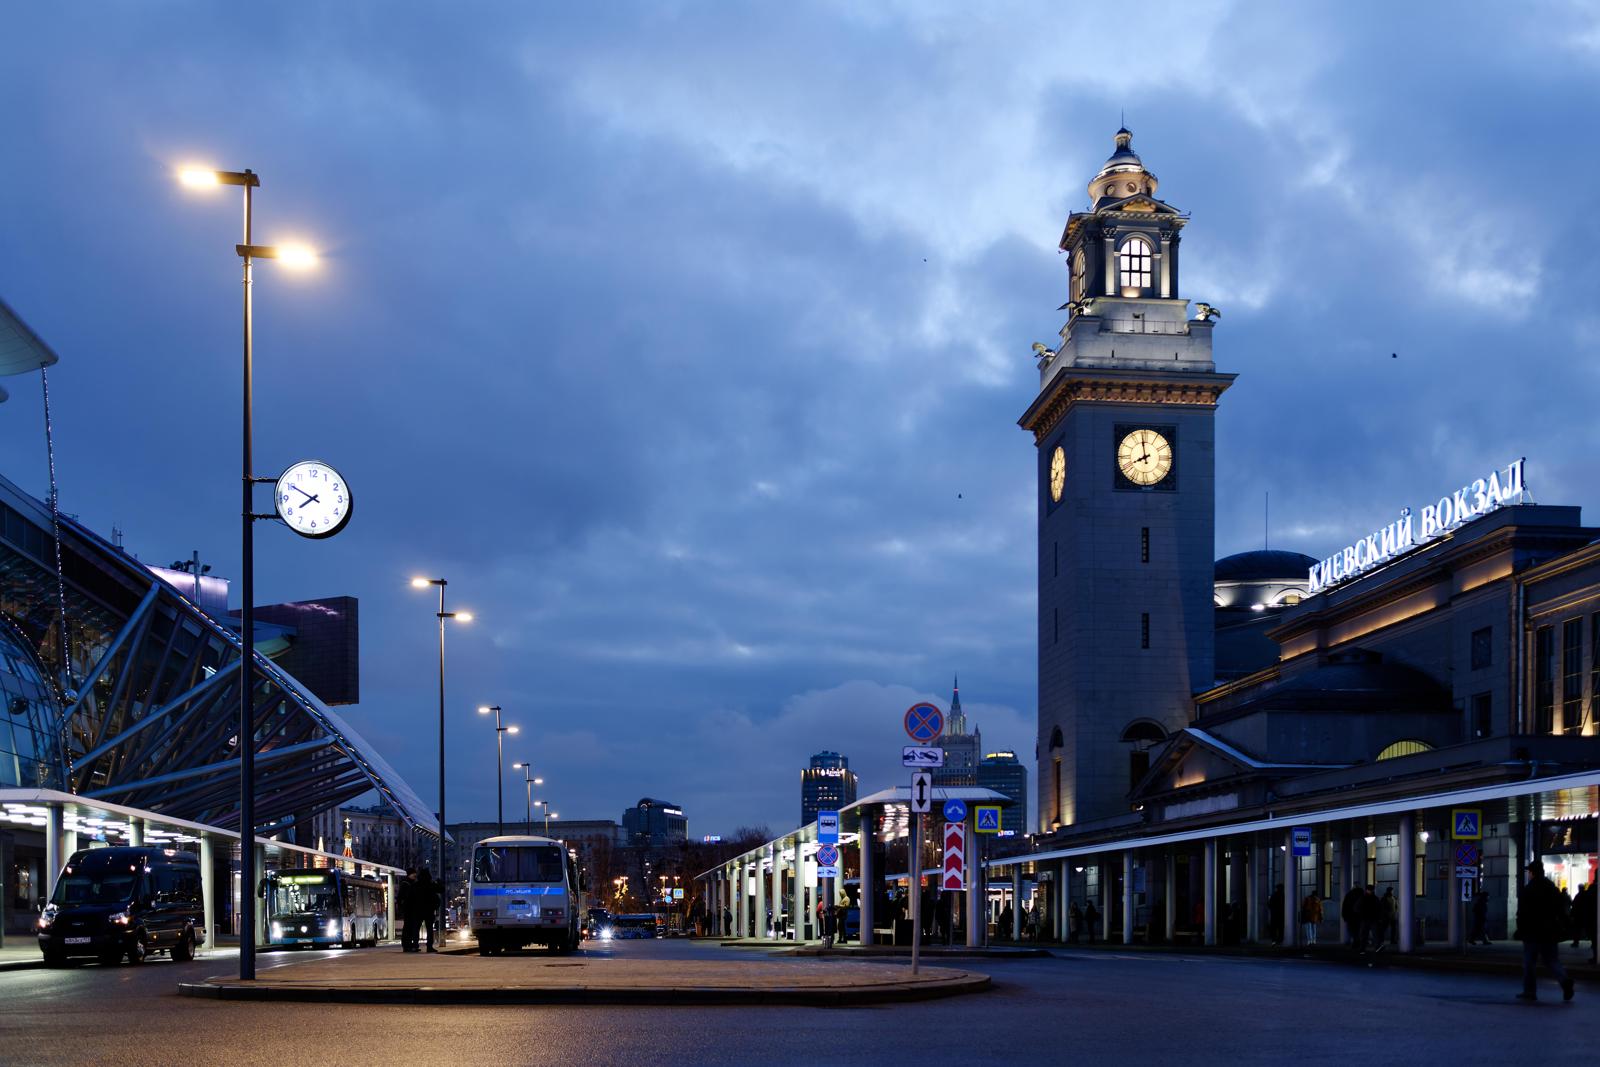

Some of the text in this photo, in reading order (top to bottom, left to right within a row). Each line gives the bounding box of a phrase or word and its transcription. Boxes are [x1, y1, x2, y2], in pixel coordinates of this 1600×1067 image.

[297, 474, 303, 482] 11
[309, 470, 318, 478] 12
[324, 474, 328, 482] 1
[333, 483, 339, 491] 2
[283, 494, 289, 503] 9
[337, 495, 343, 503] 3
[288, 507, 293, 515] 8
[333, 507, 339, 516] 4
[298, 516, 303, 524] 7
[311, 520, 316, 528] 6
[1308, 458, 1525, 593] КИЕВСКИЙ ВОКЗАЛ
